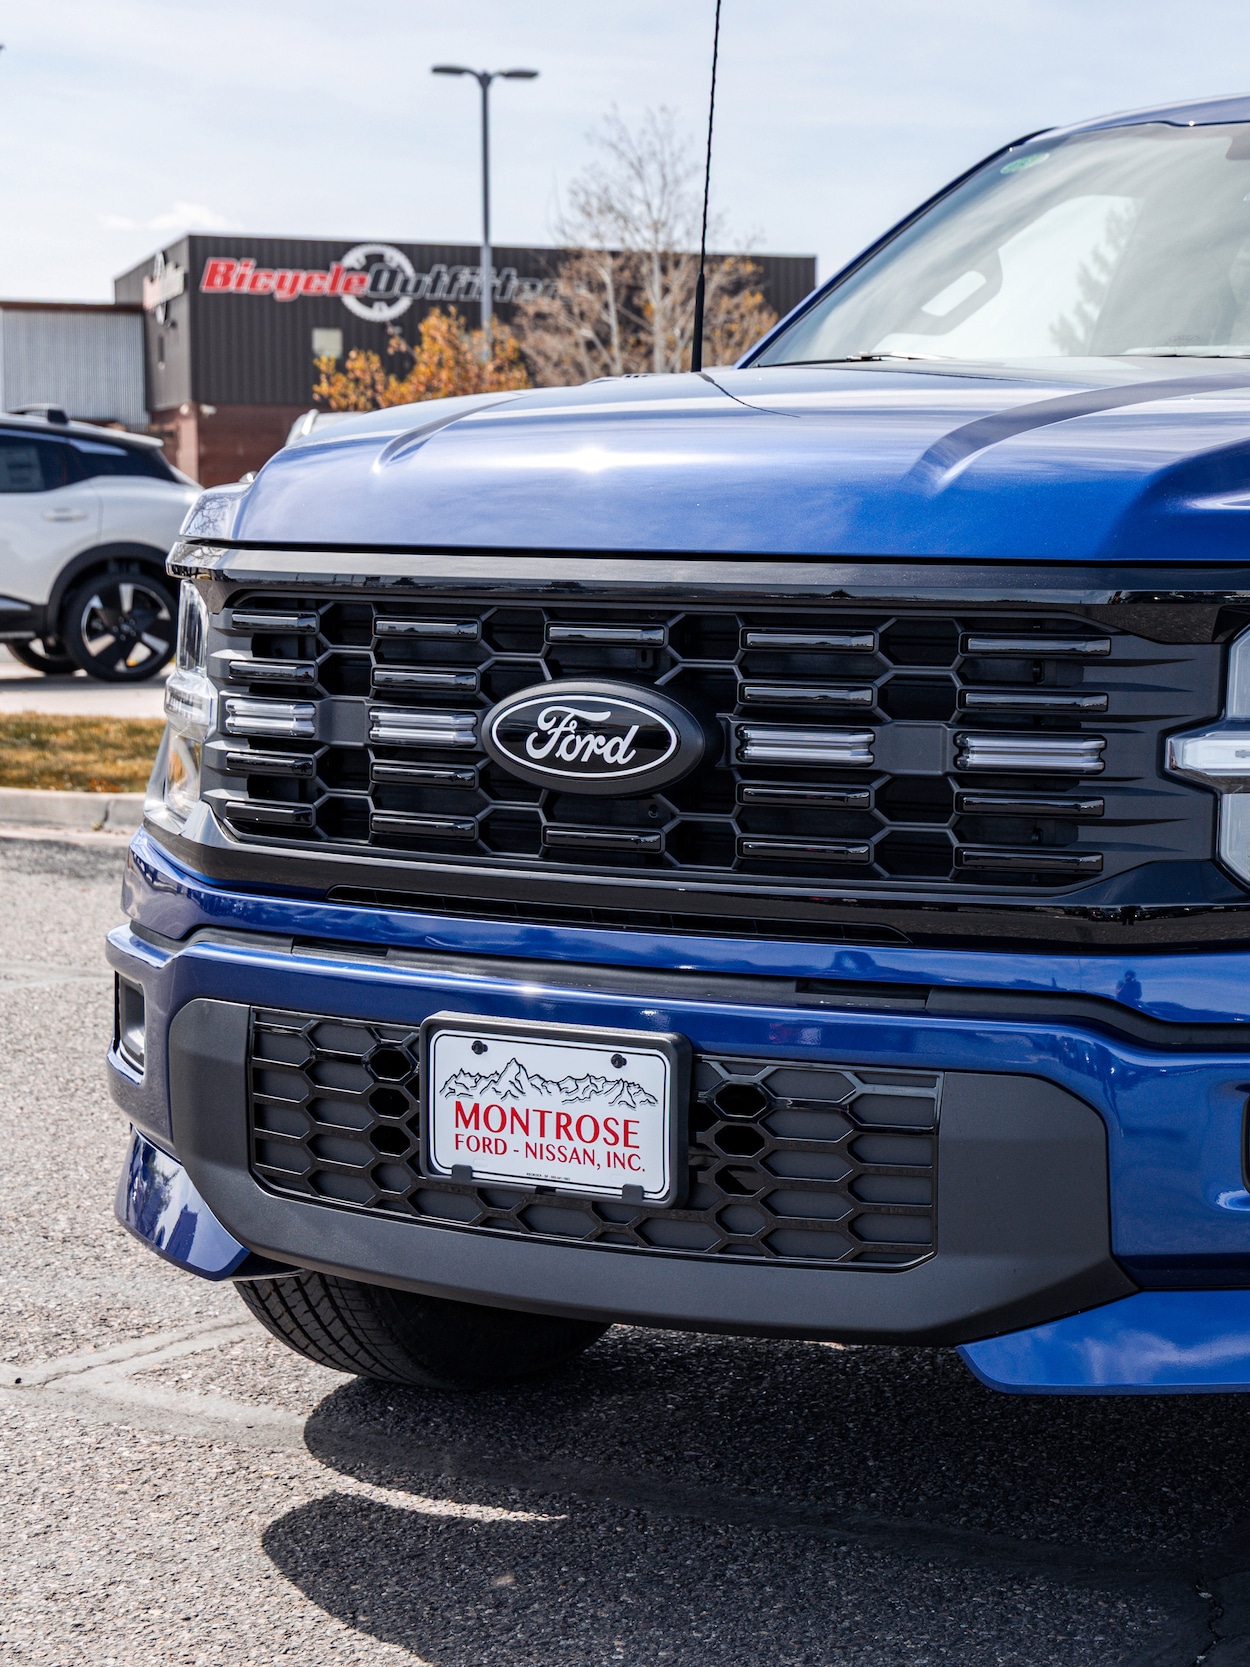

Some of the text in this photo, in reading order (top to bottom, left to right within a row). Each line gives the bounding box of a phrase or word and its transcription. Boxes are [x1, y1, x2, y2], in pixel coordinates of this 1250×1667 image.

[201, 257, 369, 302] Bicycle
[526, 705, 640, 765] Ford
[455, 1101, 640, 1149] MONTROSE
[455, 1133, 508, 1155] FORD
[525, 1141, 600, 1170] NISSAN,
[606, 1151, 646, 1172] INC.
